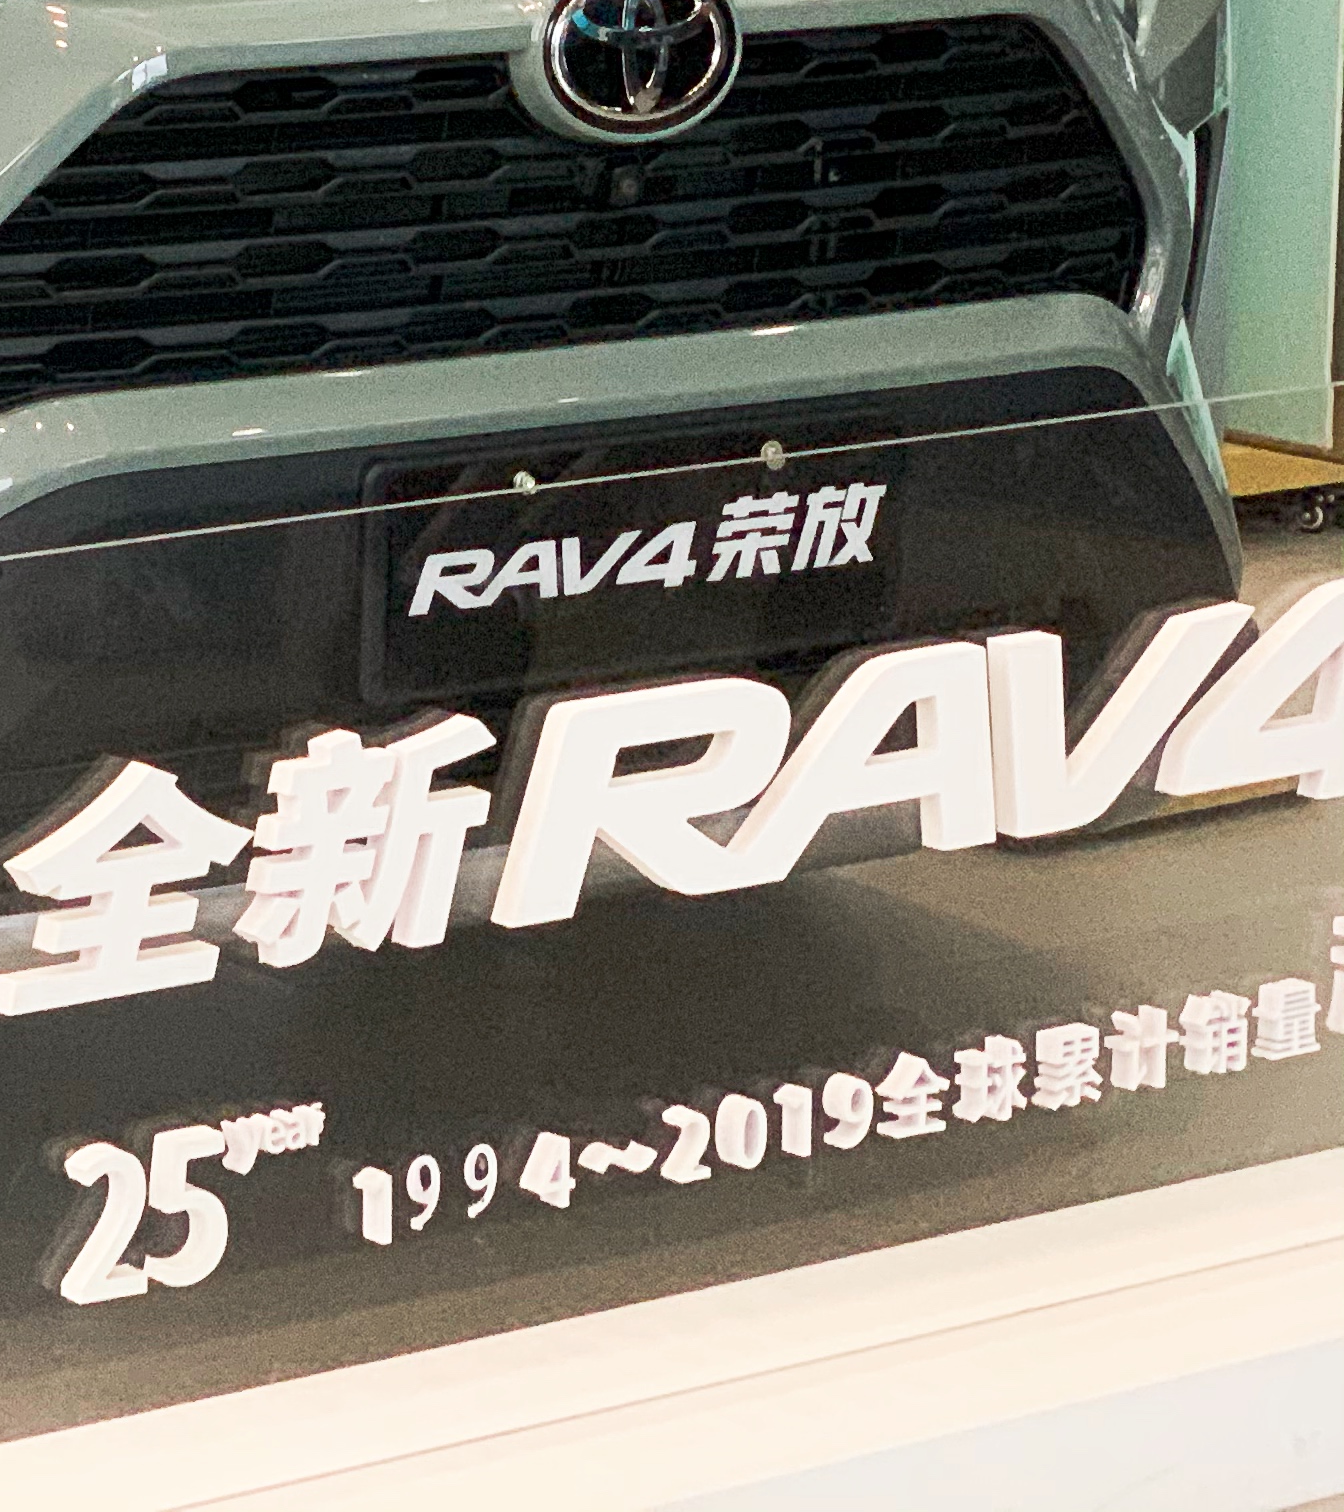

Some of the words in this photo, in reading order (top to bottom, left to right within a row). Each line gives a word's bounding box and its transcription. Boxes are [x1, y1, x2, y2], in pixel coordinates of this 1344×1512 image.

[408, 481, 888, 618] RAV4荣放
[352, 916, 1344, 1246] 1994~2019全球累计销量
[60, 1124, 229, 1306] 25
[220, 1101, 327, 1176] year
